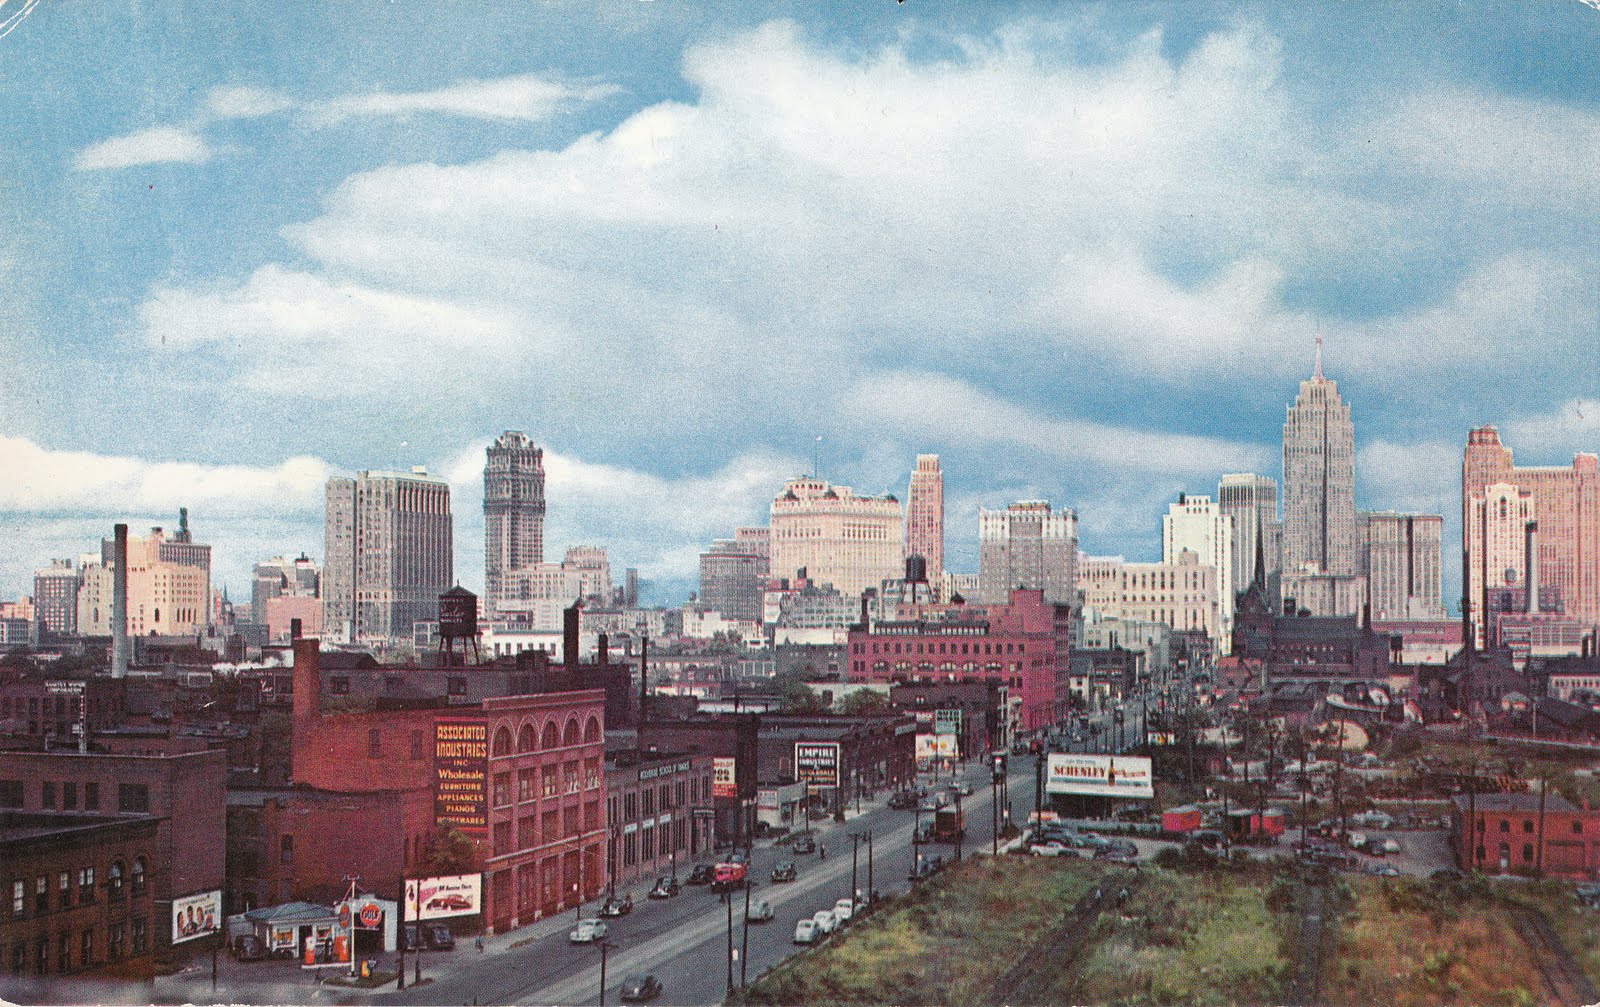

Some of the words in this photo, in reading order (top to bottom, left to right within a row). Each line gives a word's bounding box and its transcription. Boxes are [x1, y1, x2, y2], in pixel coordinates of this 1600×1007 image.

[437, 725, 486, 740] ASSOCIATED
[436, 742, 487, 757] INDUSTRIES
[799, 747, 835, 758] EMPIRE
[453, 759, 468, 767] INC
[438, 769, 485, 780] Wholesale
[1054, 765, 1106, 778] SCHENLEY
[440, 782, 482, 791] FURNITURE
[437, 793, 484, 801] APPLIANCES
[446, 804, 476, 813] PIANOS
[361, 909, 381, 920] GULF
